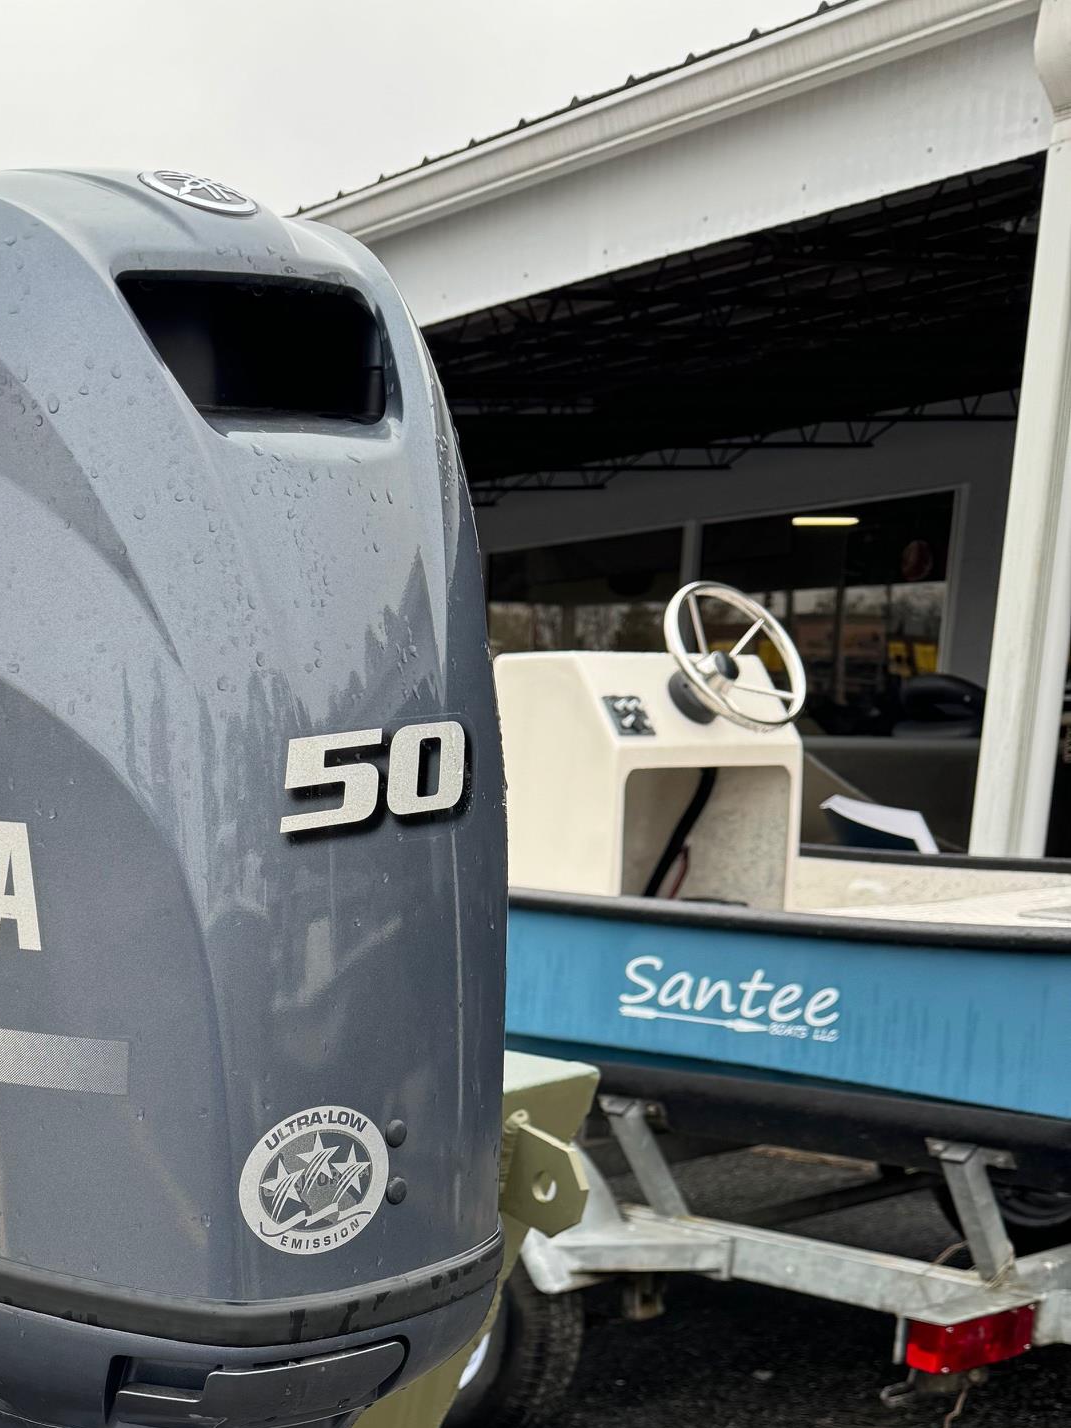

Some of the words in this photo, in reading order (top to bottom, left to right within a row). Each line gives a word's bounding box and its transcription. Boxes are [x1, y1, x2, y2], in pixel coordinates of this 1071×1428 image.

[280, 720, 466, 834] 50
[619, 955, 840, 1027] Santee
[280, 1218, 360, 1250] EMISSION
